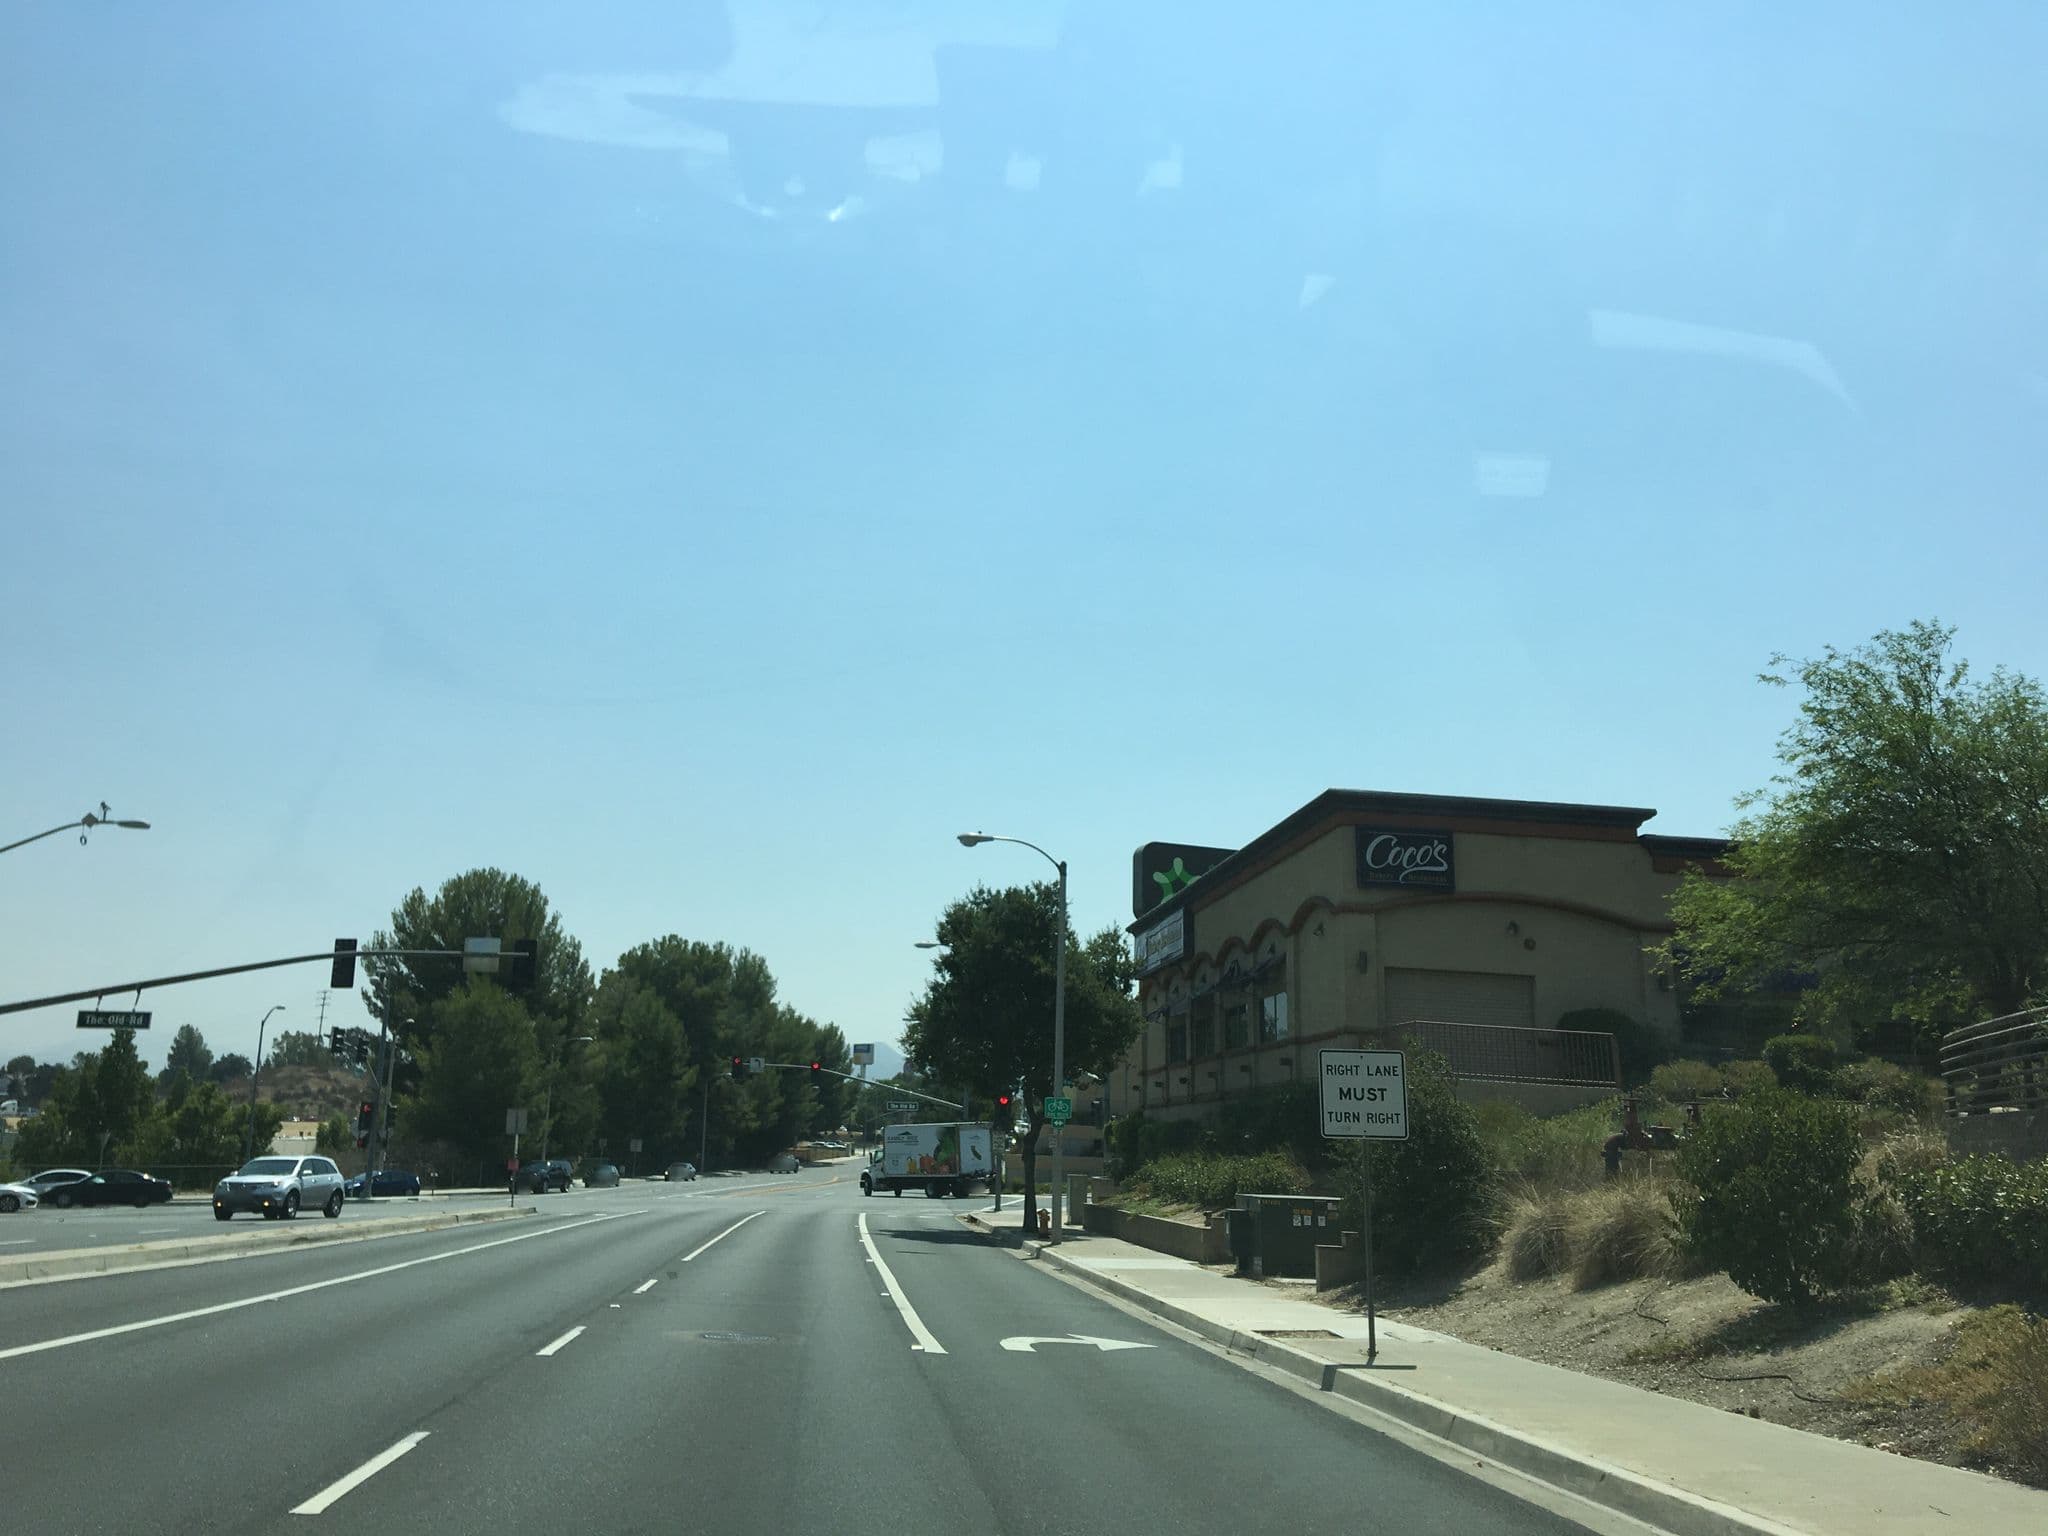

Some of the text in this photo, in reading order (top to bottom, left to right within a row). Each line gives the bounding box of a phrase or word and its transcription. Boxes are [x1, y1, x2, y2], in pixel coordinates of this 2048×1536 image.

[1366, 834, 1448, 884] Coco's
[86, 1015, 143, 1025] The Old Rd
[1326, 1064, 1399, 1077] RIGHT LANE
[1339, 1087, 1387, 1102] MUST
[1327, 1111, 1401, 1124] TURN RIGHT
